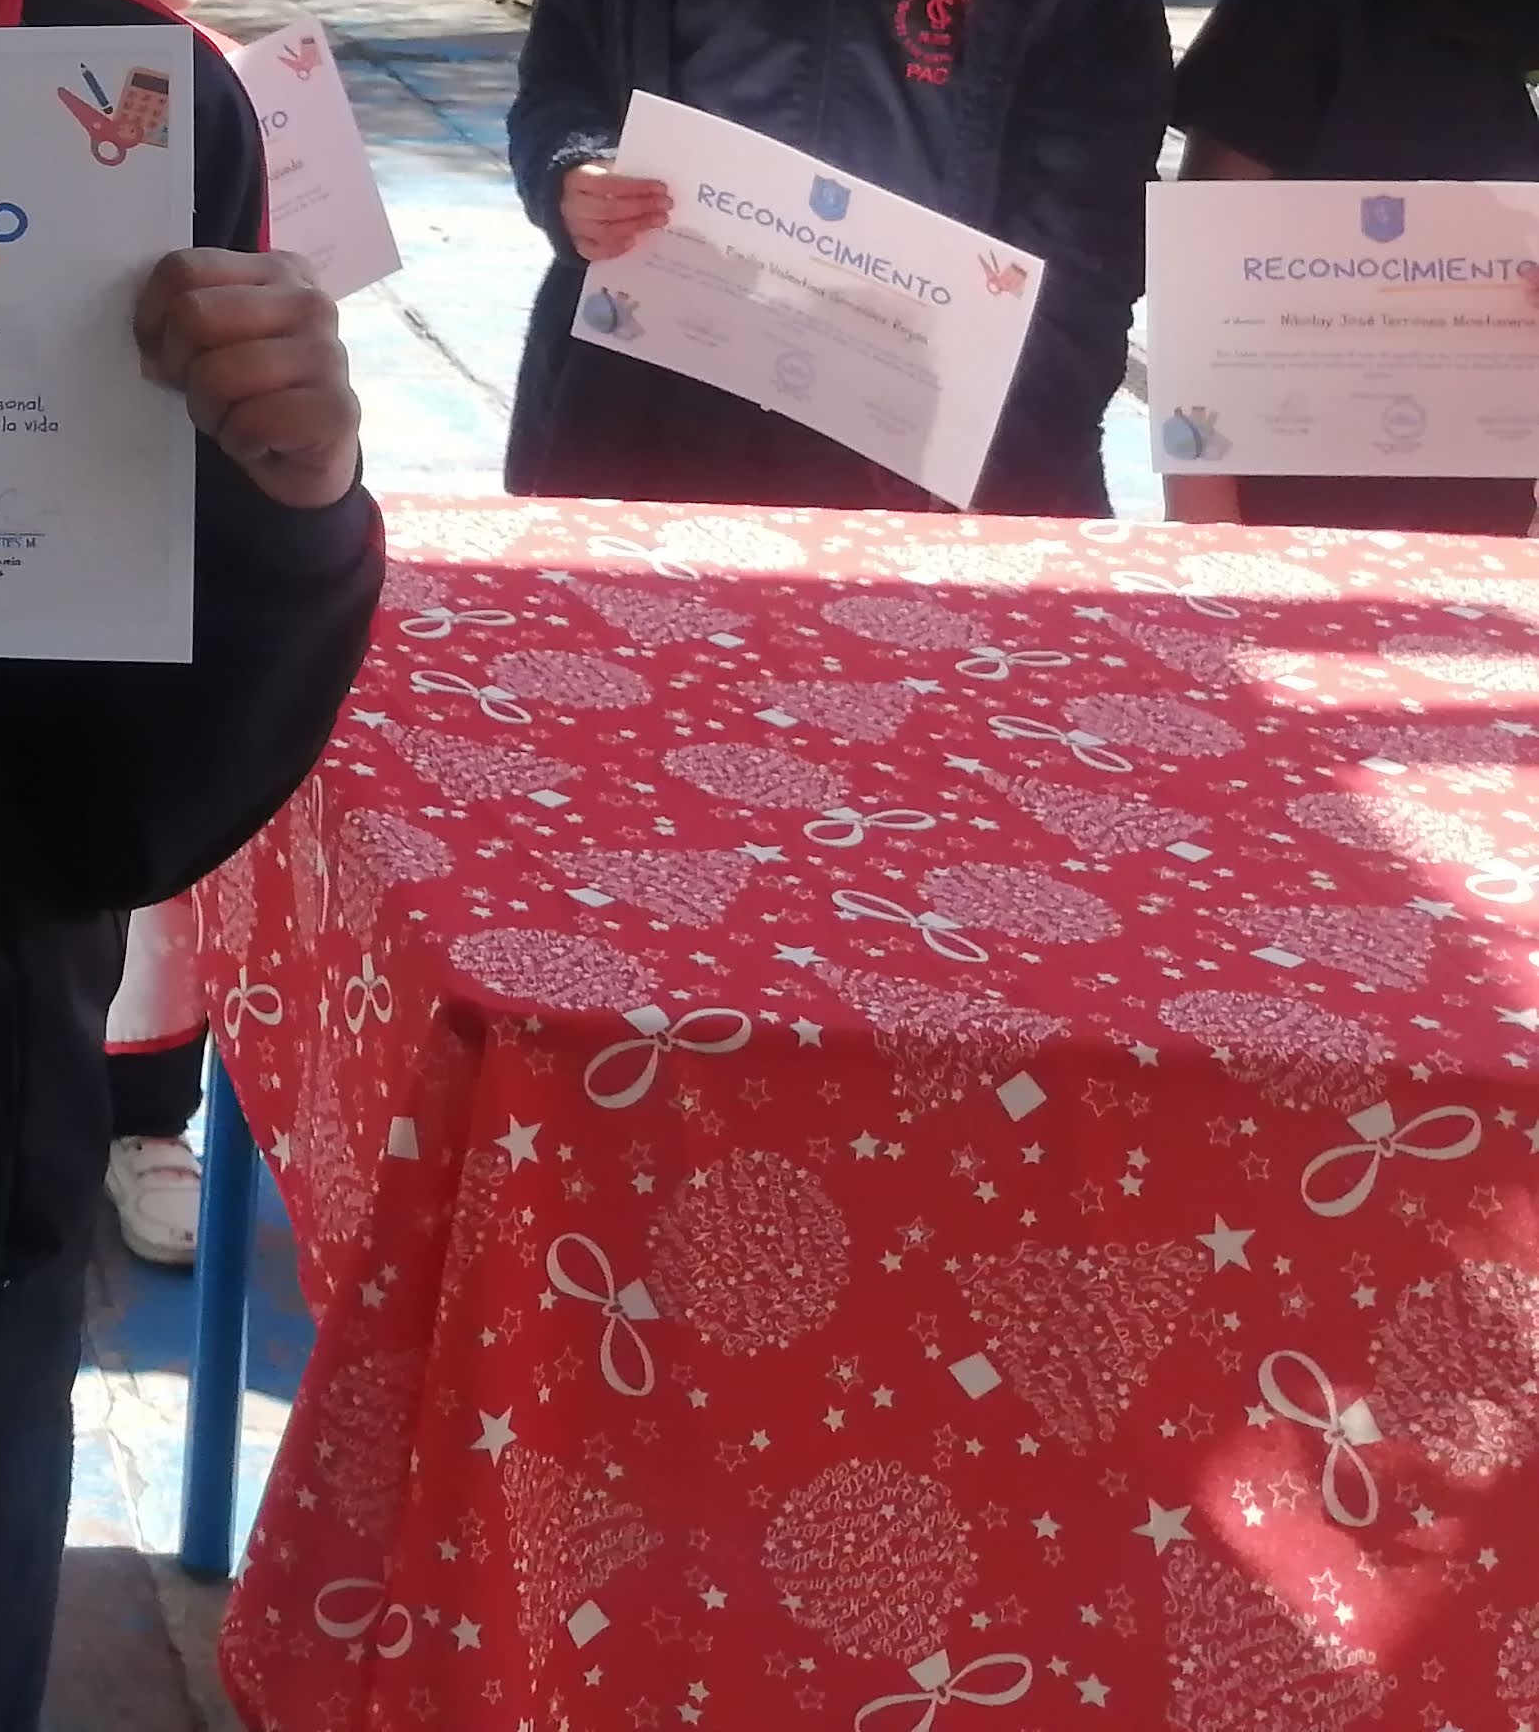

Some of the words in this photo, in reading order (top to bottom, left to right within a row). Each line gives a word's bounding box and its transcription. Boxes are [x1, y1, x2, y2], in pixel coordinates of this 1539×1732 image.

[697, 183, 952, 305] RECONOCIMIENTO
[2, 416, 17, 433] la
[24, 417, 59, 433] vida
